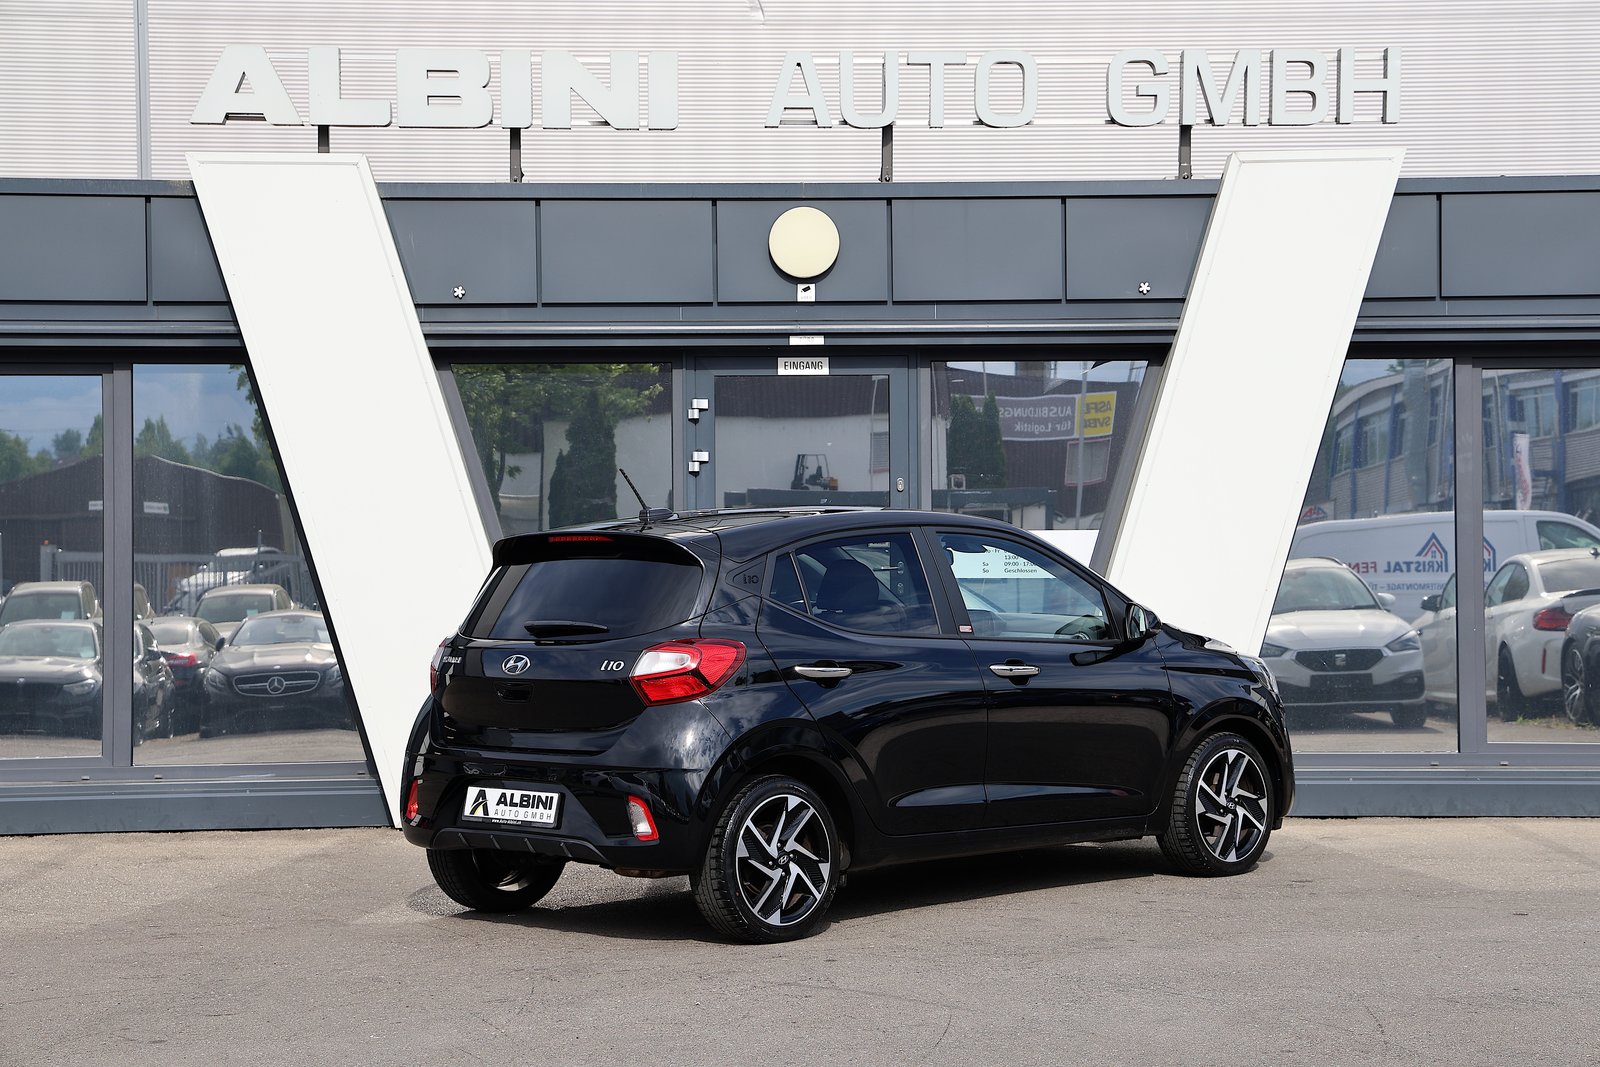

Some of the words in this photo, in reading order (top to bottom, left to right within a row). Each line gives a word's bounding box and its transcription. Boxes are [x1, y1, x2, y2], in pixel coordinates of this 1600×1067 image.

[188, 44, 679, 130] ALBINI
[764, 48, 1039, 129] AUTO
[1105, 46, 1400, 128] GMBH
[783, 361, 823, 371] EINGANG
[496, 792, 555, 811] ALBINI
[494, 808, 520, 818] AUTO
[523, 810, 552, 820] GMBH
